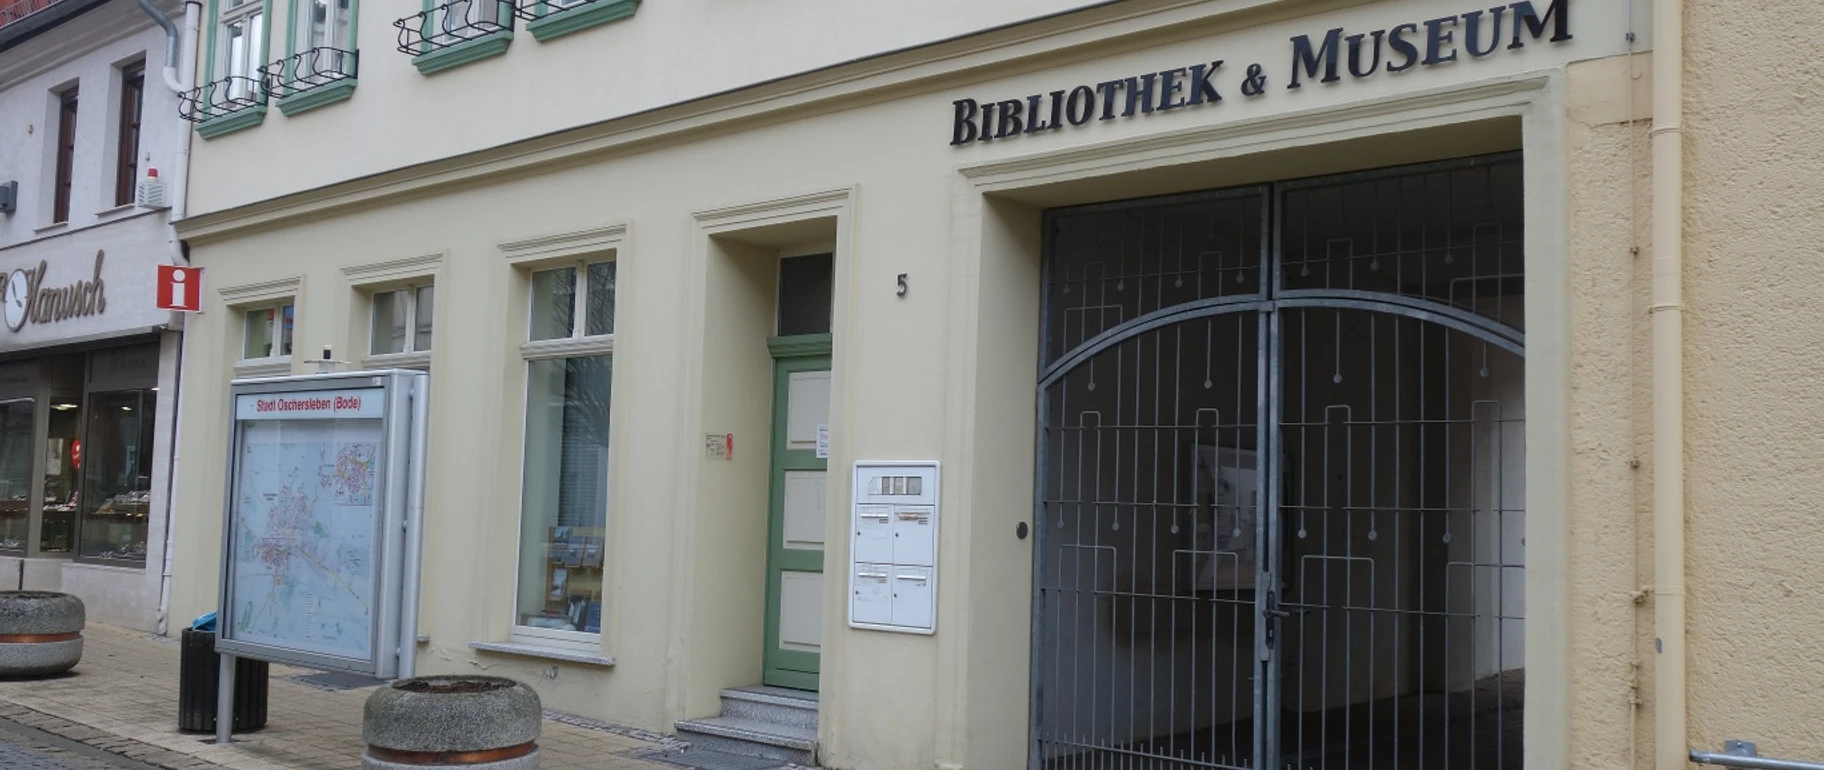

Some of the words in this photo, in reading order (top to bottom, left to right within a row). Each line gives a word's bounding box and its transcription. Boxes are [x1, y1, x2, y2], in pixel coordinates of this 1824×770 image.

[949, 60, 1224, 146] BIBLIOTHEK
[1240, 63, 1267, 97] &
[1286, 0, 1573, 89] MUSEUM
[26, 249, 106, 325] Hanusch
[896, 273, 908, 297] 5
[256, 399, 276, 412] Stadt
[277, 397, 331, 411] Oschersleben
[333, 396, 361, 411] (Bode)
